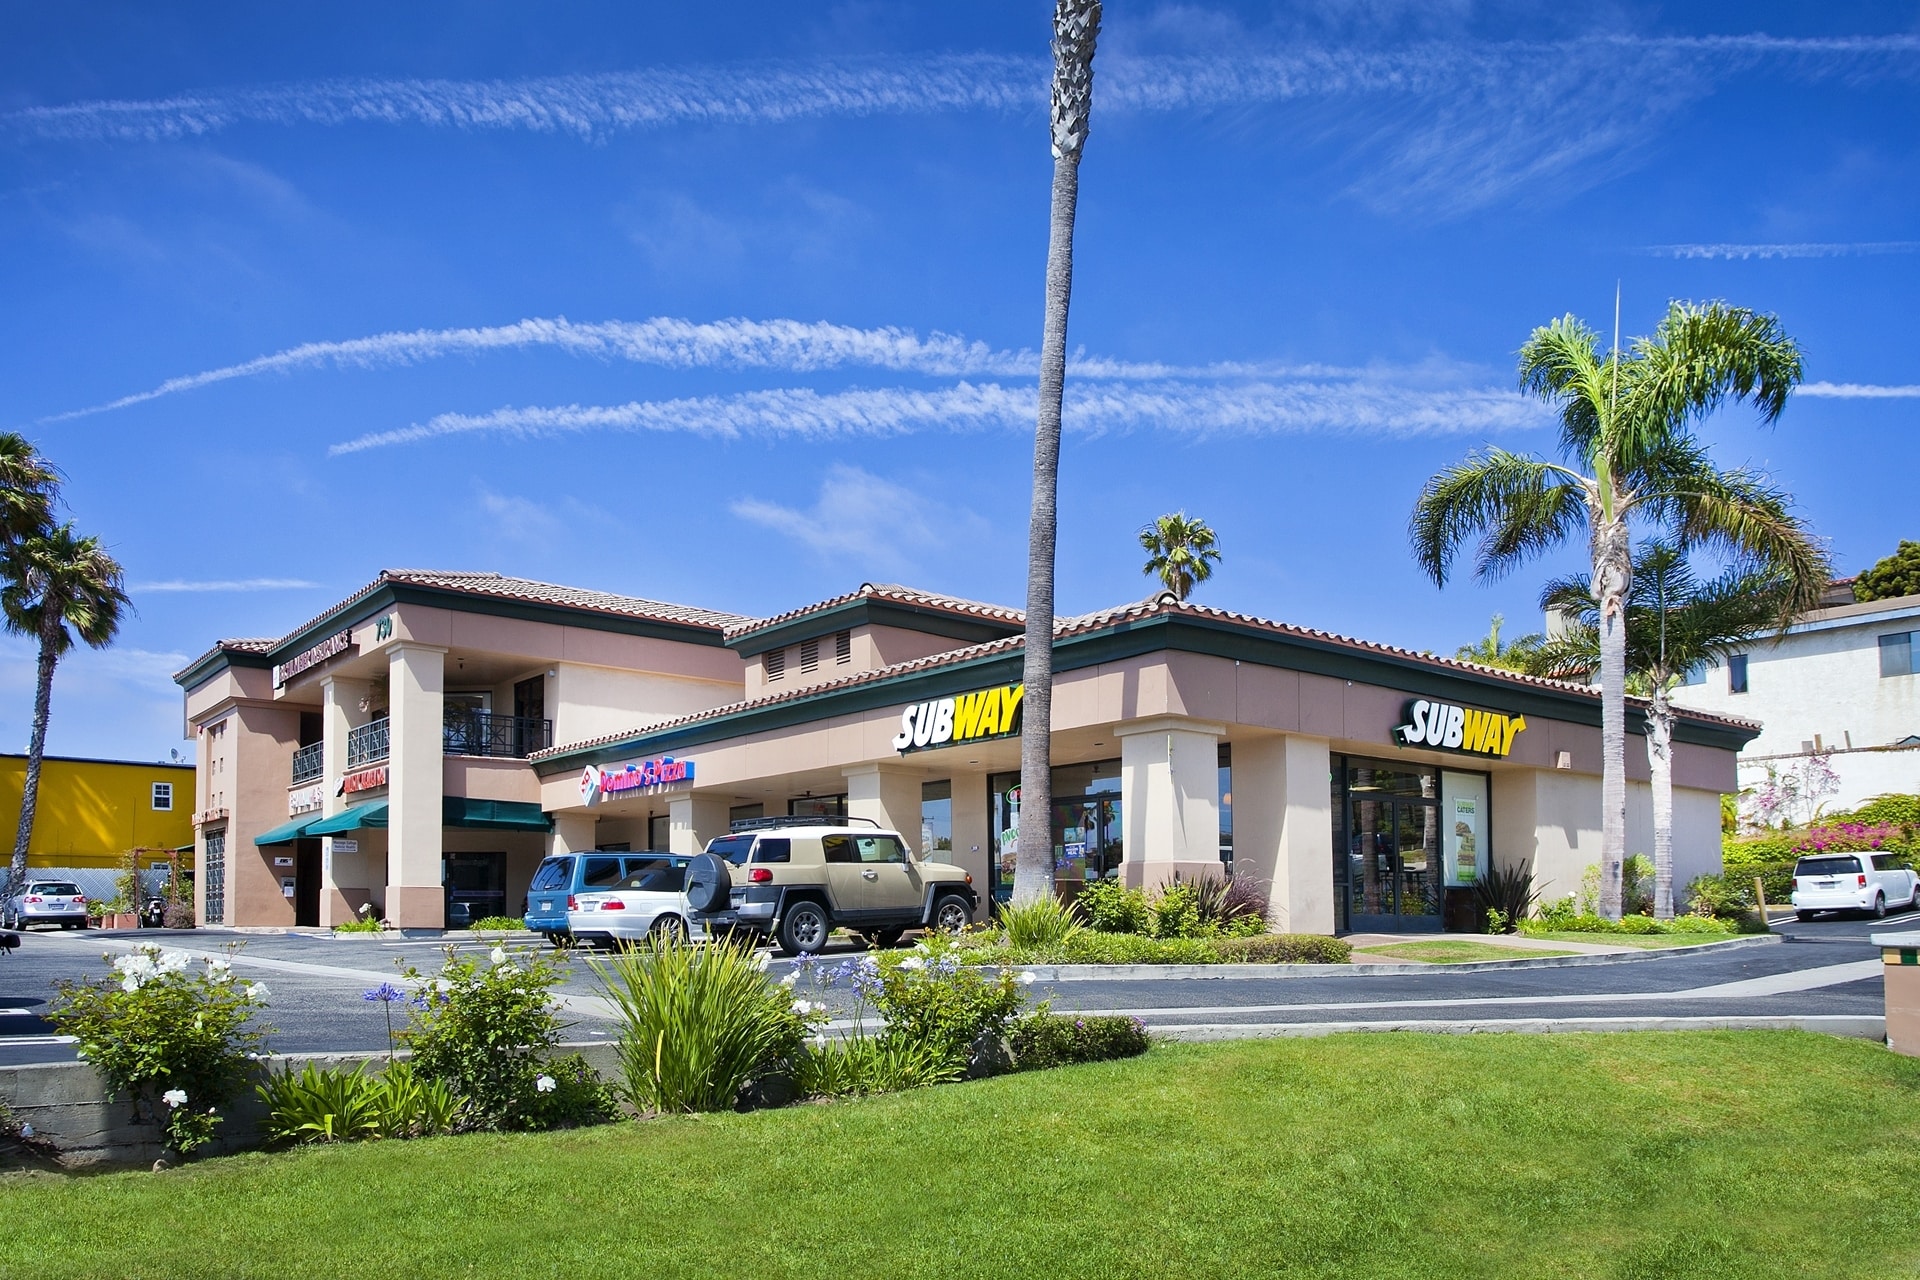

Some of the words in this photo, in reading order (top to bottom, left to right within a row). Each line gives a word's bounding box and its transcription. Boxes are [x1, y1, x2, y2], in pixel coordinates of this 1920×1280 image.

[310, 629, 349, 666] INSURANCE
[892, 684, 1024, 751] SUBWAY
[1396, 700, 1527, 756] SUBWAY
[600, 763, 651, 792] Domino's
[653, 757, 687, 783] Pizza
[1457, 806, 1475, 814] CATERS
